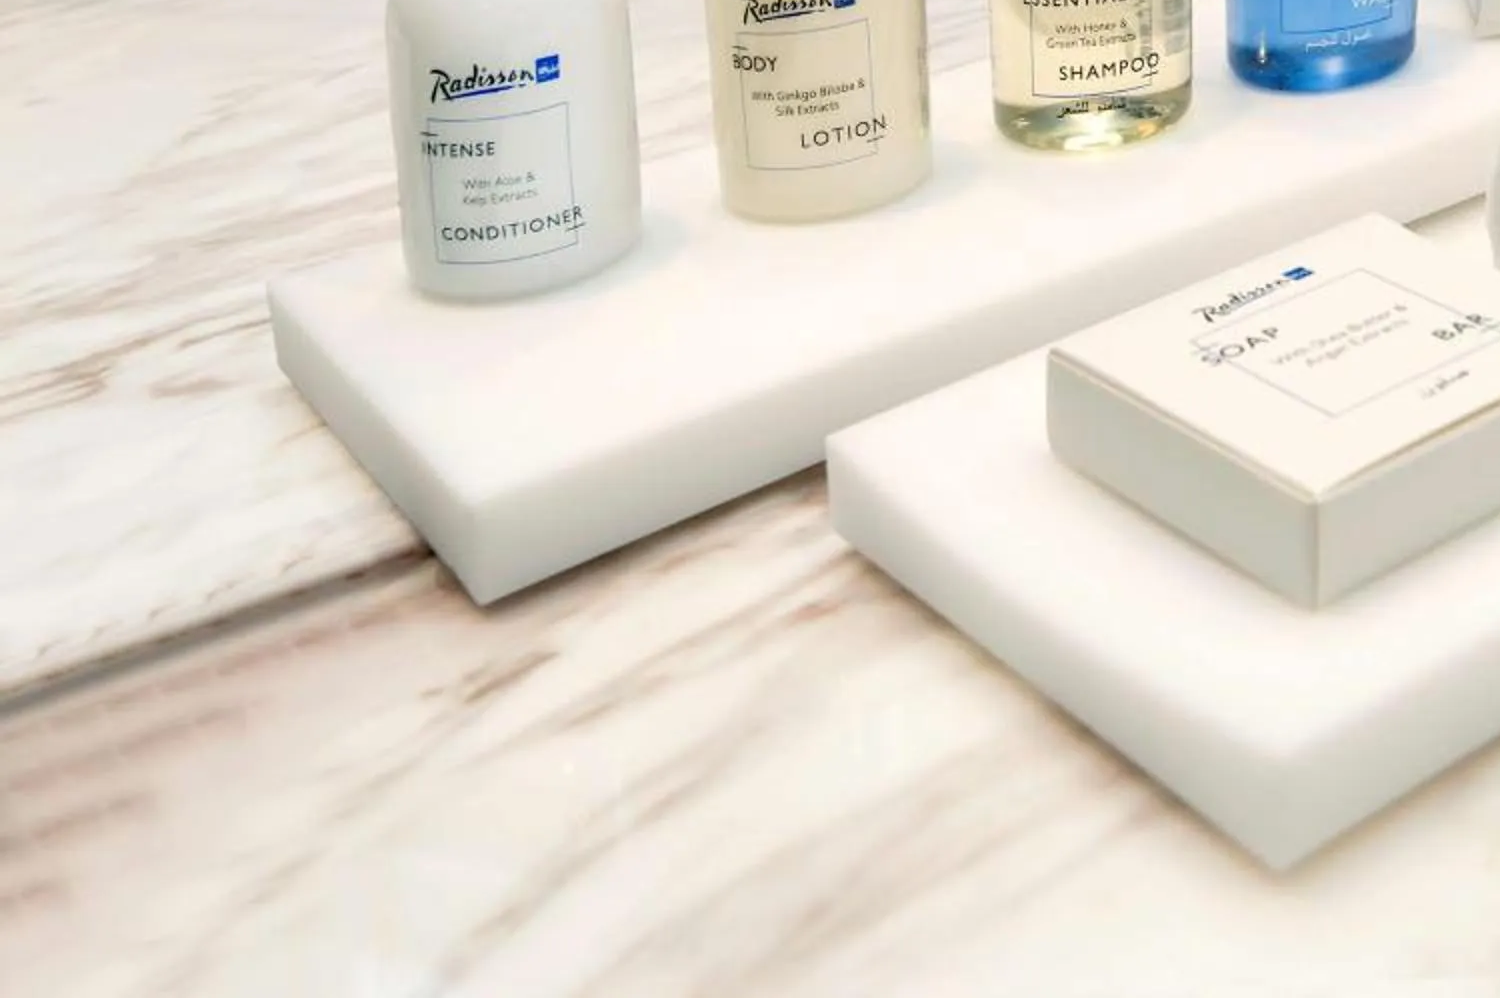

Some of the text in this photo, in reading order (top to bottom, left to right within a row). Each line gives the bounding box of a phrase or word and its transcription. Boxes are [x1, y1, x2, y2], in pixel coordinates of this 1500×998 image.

[1056, 18, 1127, 35] With Honey &
[1046, 37, 1078, 49] Green
[1079, 36, 1096, 47] Tea
[732, 54, 778, 72] BODY
[1059, 52, 1160, 81] SHAMPOO
[430, 63, 535, 102] Radisson
[752, 90, 775, 101] With
[777, 88, 817, 103] Ginkgo
[858, 78, 865, 88] &
[797, 101, 839, 116] Extracts
[800, 114, 887, 149] LOTION
[421, 141, 496, 158] INTENSE
[463, 177, 491, 190] With
[526, 171, 536, 182] &
[490, 189, 538, 205] Extracts
[441, 206, 582, 242] CONDITIONER
[1431, 312, 1495, 342] BAR
[1200, 326, 1279, 366] SOAP
